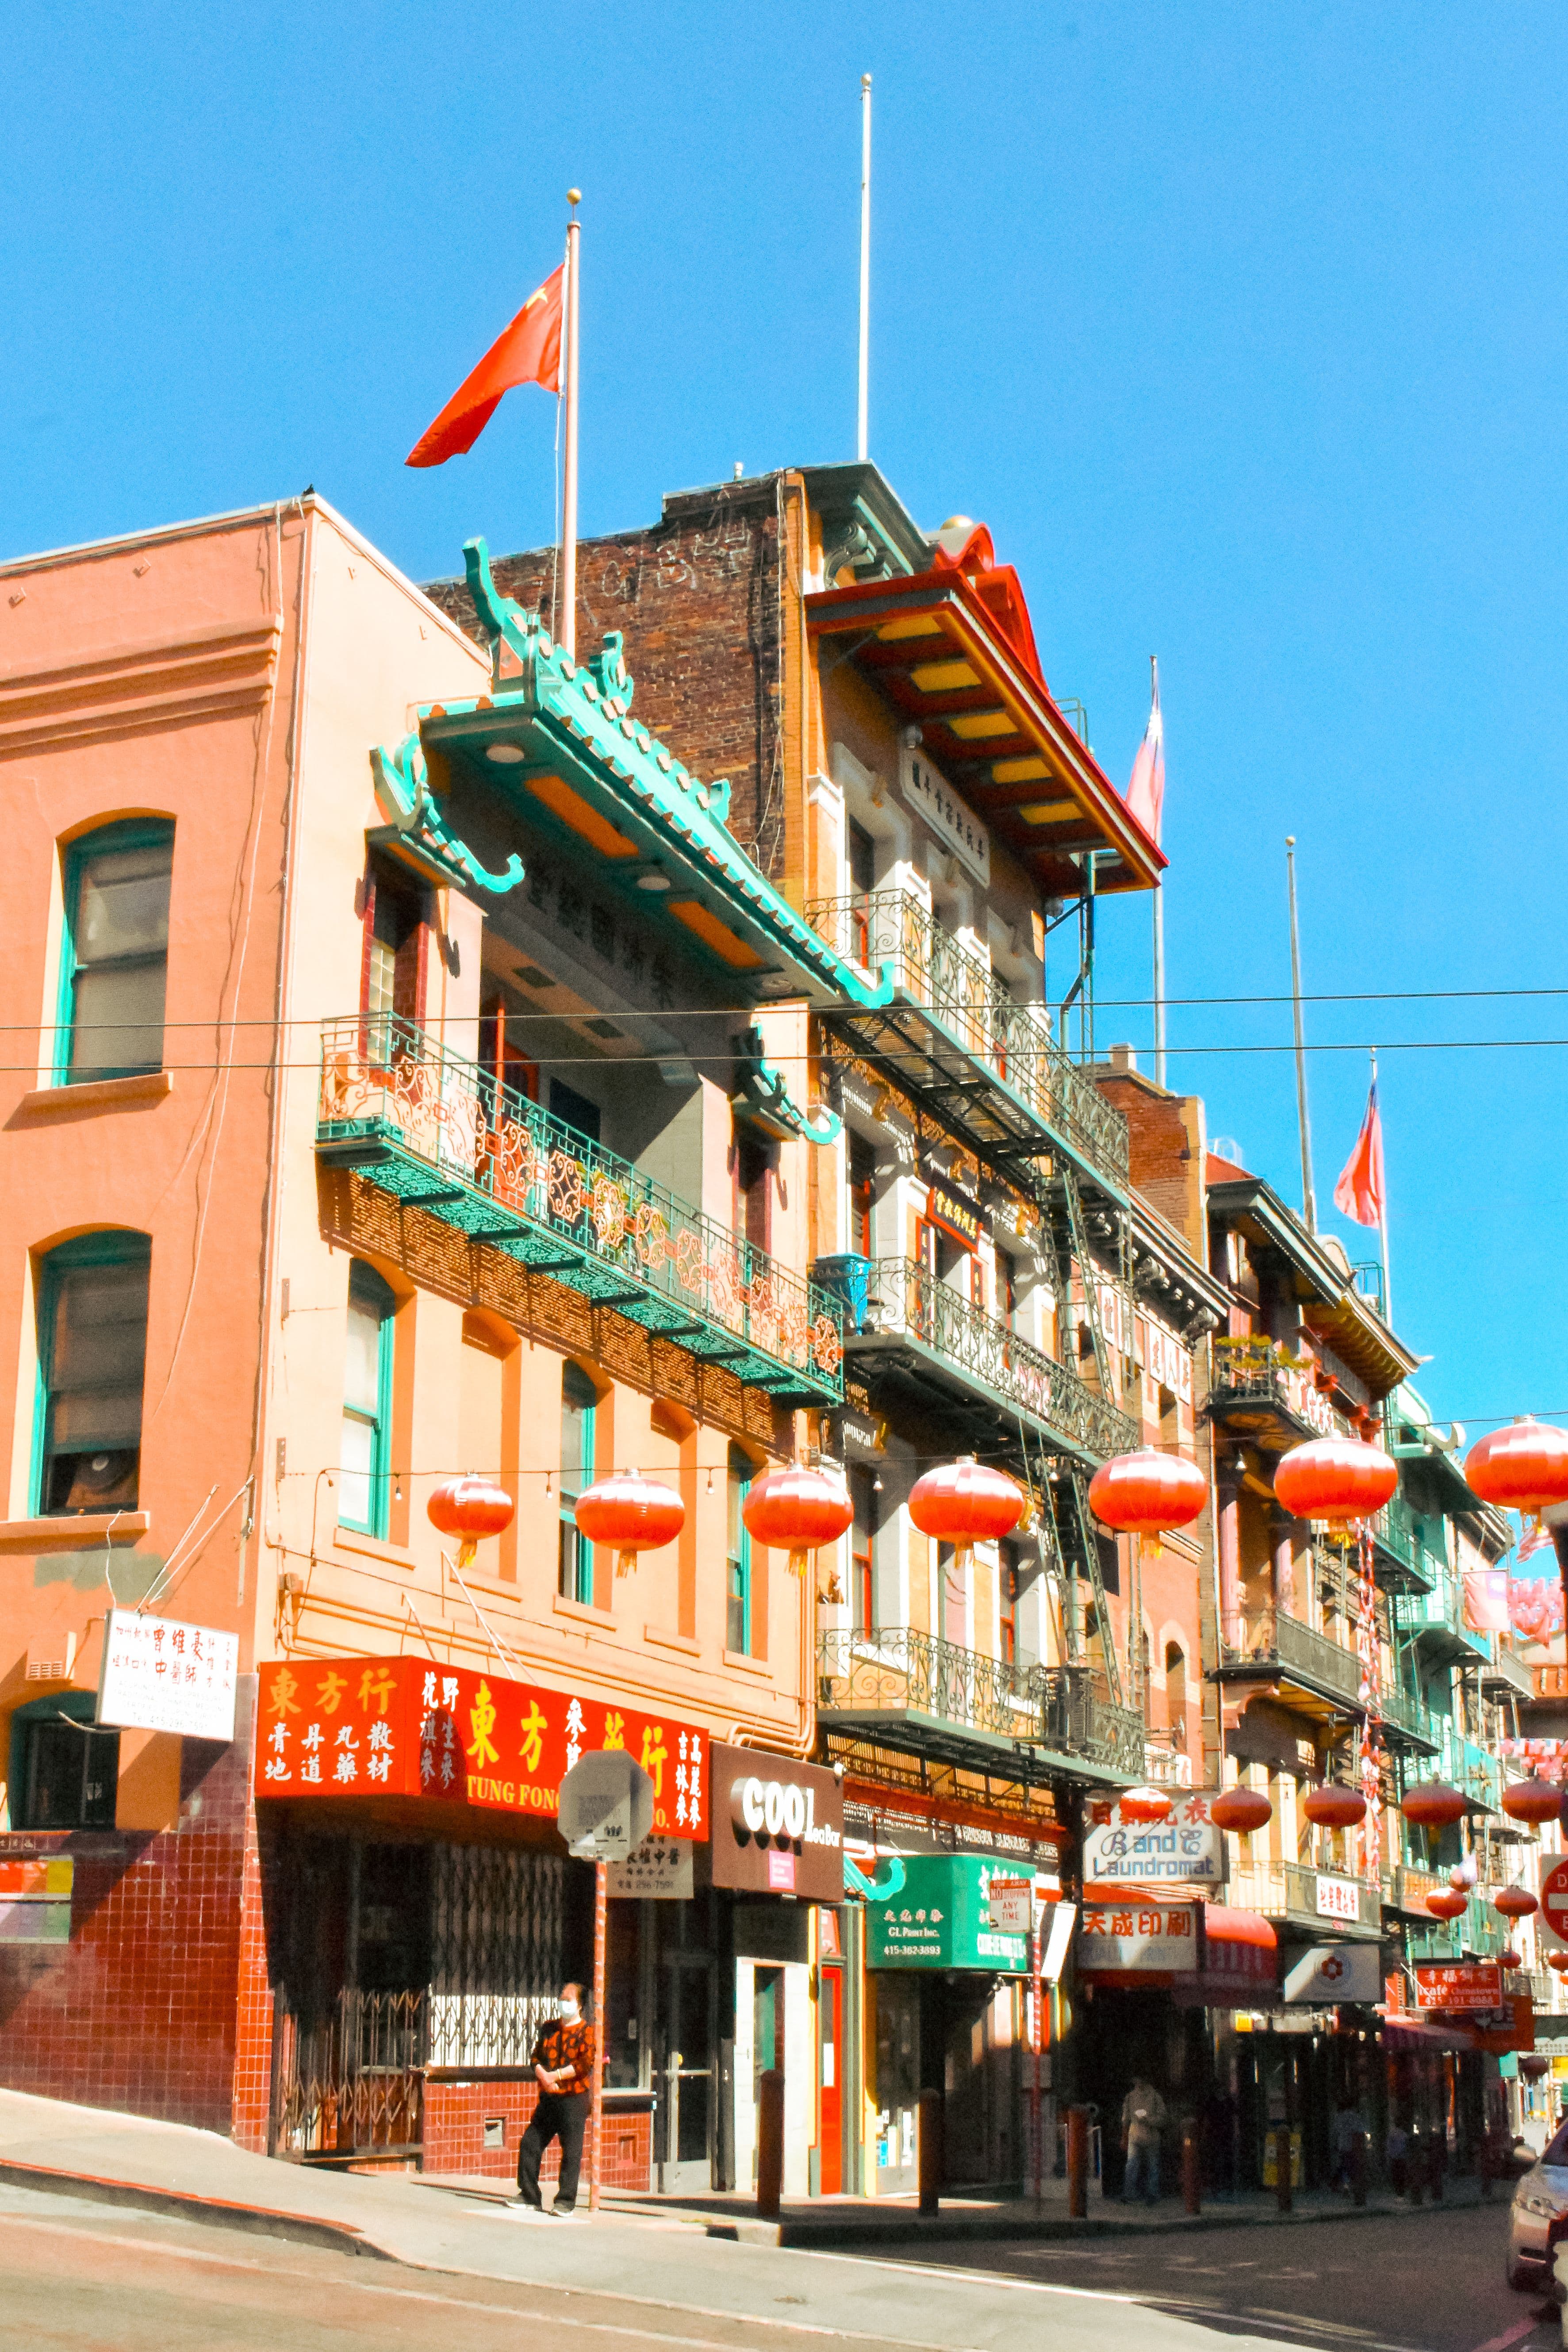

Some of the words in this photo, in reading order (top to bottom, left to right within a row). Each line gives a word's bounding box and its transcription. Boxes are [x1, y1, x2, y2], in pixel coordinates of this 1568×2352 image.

[155, 1659, 197, 1688] 中醫師
[266, 1667, 397, 1718] 東方行
[268, 1720, 395, 1753] 膏丹丸散
[441, 1677, 459, 1789] 野生參
[265, 1752, 393, 1783] 地道藥材
[675, 1731, 689, 1826] 吉林參
[468, 1775, 515, 1803] TUNG
[1133, 1829, 1177, 1853] and
[1093, 1856, 1214, 1875] Laundromat
[1002, 1912, 1019, 1920] TIME
[1084, 1911, 1190, 1937] 天成印刷
